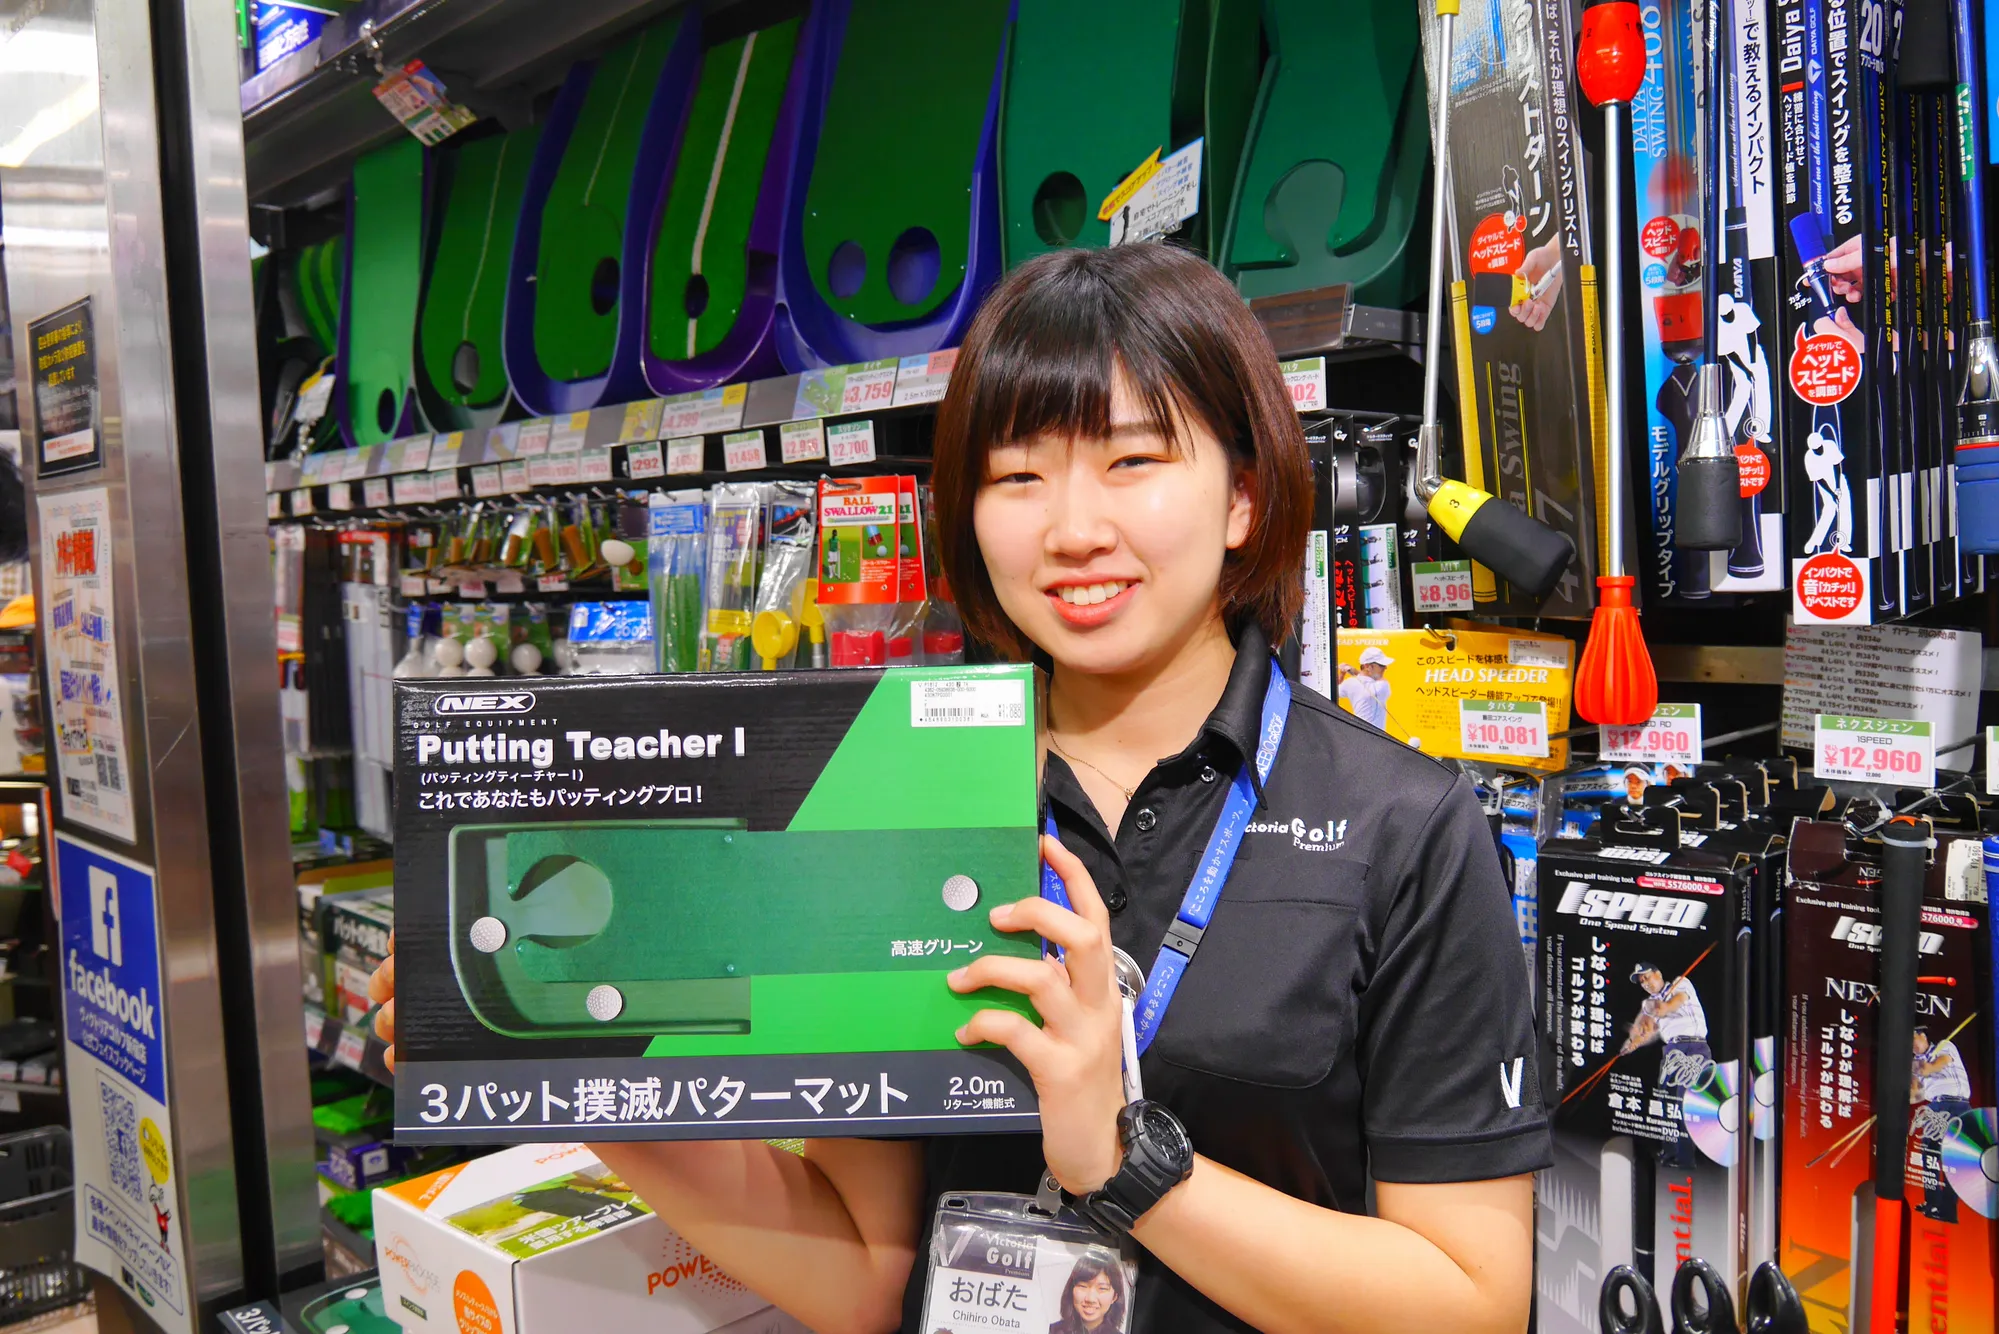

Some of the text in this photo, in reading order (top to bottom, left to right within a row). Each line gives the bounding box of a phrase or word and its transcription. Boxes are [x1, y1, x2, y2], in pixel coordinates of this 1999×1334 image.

[1860, 0, 1883, 57] 20
[1892, 10, 1903, 60] 2
[1781, 8, 1805, 73] Daiya
[1632, 87, 1649, 154] DAIYA
[1649, 85, 1669, 159] SWING
[1646, 225, 1672, 236] ヘッド
[1473, 238, 1521, 259] ヘッドスピード
[1644, 235, 1677, 249] スピード
[1788, 293, 1802, 305] カチ
[1794, 297, 1813, 311] カチッ
[1806, 339, 1843, 352] ダイヤルで
[1802, 349, 1846, 369] ヘッド
[1797, 366, 1856, 387] スピード
[1289, 382, 1316, 402] 02
[1808, 384, 1844, 398] を調節!
[1497, 359, 1524, 480] Swing
[824, 504, 894, 517] SWALLOW 21
[843, 496, 874, 506] BALL
[1651, 425, 1677, 600] モデルグリップタイプ
[1804, 566, 1853, 579] インパクトで
[1805, 595, 1857, 609] がベストです
[1336, 638, 1390, 646] EAD SPEEDER
[1425, 667, 1548, 684] HEAD SPEEDER
[440, 694, 532, 712] NEX
[1487, 701, 1516, 712] タバタ
[413, 717, 559, 730] GOLF EQUIPMENT
[1836, 718, 1914, 733] ネクスジェン
[1467, 724, 1537, 746] ¥10,081
[1607, 730, 1689, 752] ¥12,960
[1857, 735, 1893, 745] 1SPEED
[418, 731, 555, 769] Putting
[565, 728, 723, 762] Teacher
[1824, 746, 1922, 774] ¥12,960
[418, 785, 704, 811] これであなたもパッティングプロ!
[1291, 817, 1348, 842] Golf
[1293, 836, 1345, 852] Premium
[1554, 869, 1584, 879] Exclusive
[1584, 872, 1597, 881] golf
[1597, 873, 1621, 883] training
[1795, 896, 1826, 907] Exclusive
[1826, 899, 1840, 909] golf
[1840, 902, 1866, 913] training
[1579, 917, 1679, 936] One Speed System
[1921, 912, 1964, 926] 576000号
[890, 938, 984, 957] 高速グリーン
[1848, 942, 1866, 951] One
[69, 949, 156, 1040] facebook
[1825, 976, 1953, 1019] NEXEN
[948, 1076, 1006, 1097] 2.0m
[419, 1071, 909, 1124] 3パット撲滅パターマット
[942, 1096, 1016, 1112] リターン機能式
[1662, 1126, 1680, 1138] DVD
[984, 1231, 1035, 1250] Victoria
[986, 1246, 1033, 1269] Golf
[1004, 1268, 1030, 1278] Premium
[949, 1276, 1029, 1312] おばた
[952, 1309, 1021, 1329] Chihiro Obata
